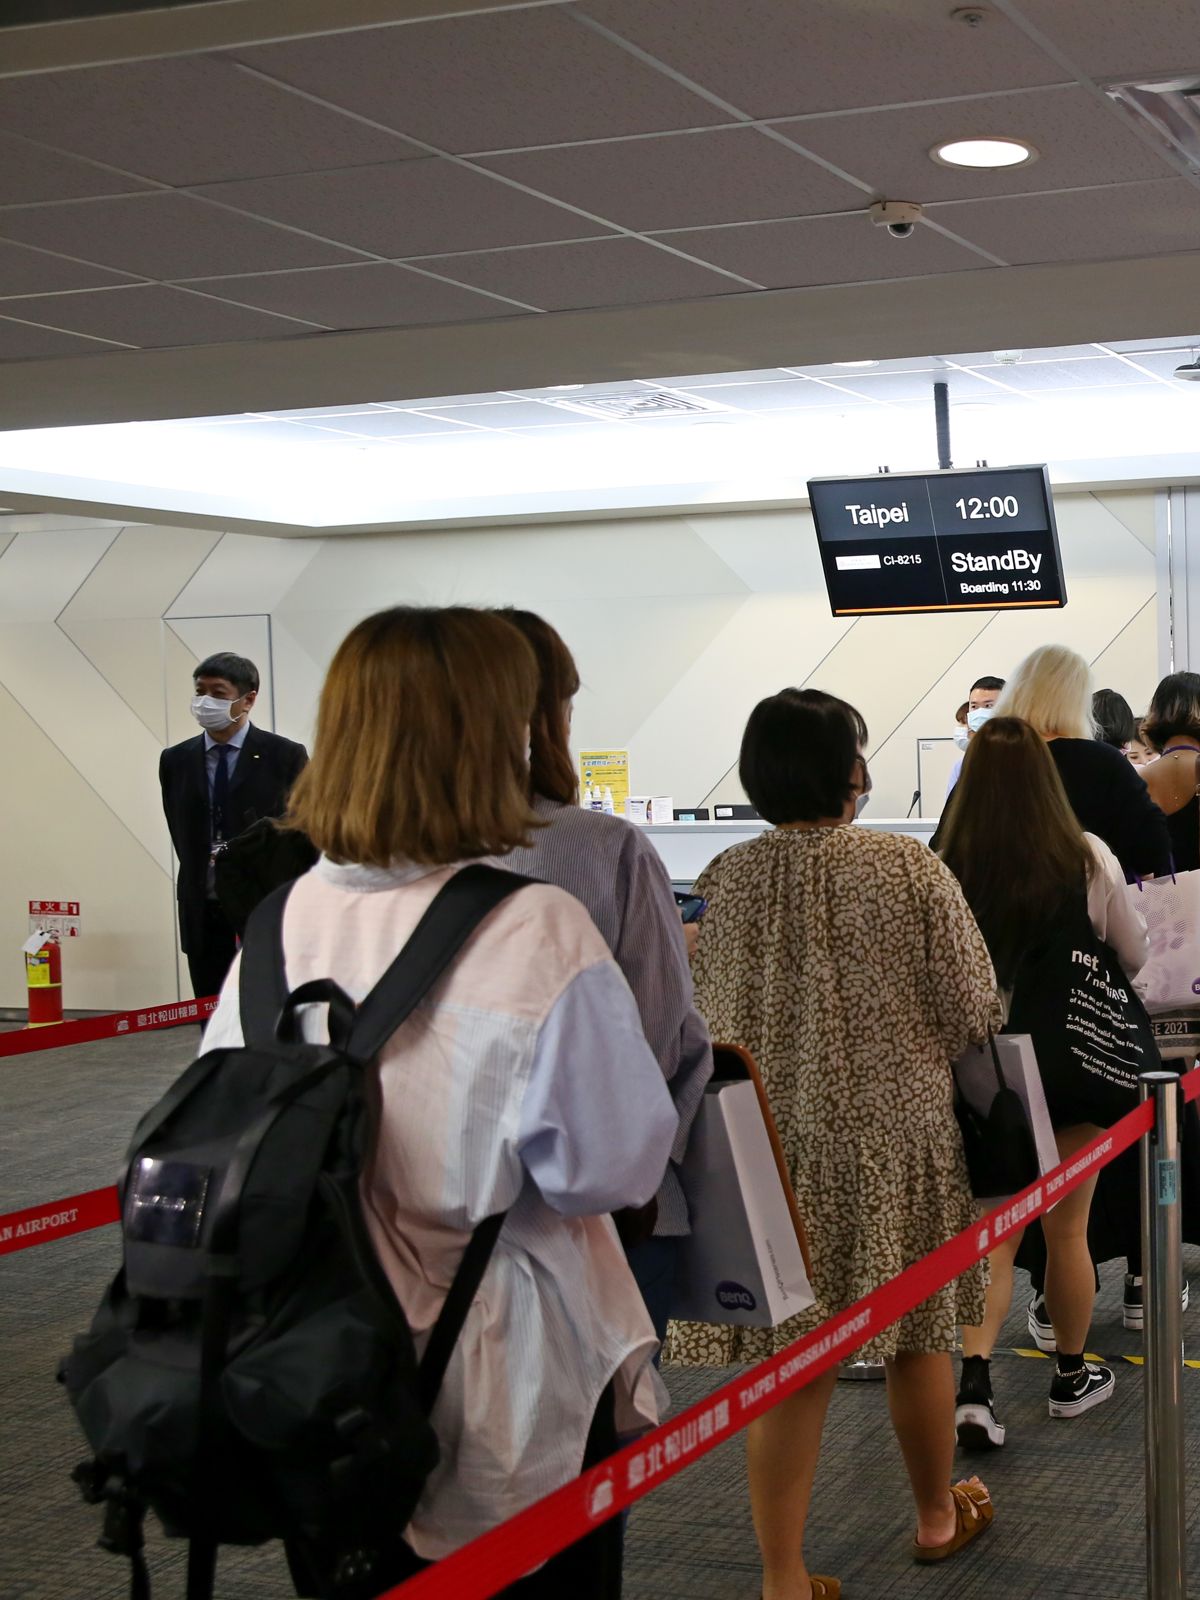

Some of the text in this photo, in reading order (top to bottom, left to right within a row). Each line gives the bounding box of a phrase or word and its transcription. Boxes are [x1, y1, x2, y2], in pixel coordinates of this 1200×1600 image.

[845, 495, 1019, 528] Taipei 12:00
[883, 554, 922, 565] CI-8215
[951, 549, 1042, 574] StandBy
[960, 579, 1042, 594] Boarding 11:30
[1066, 1023, 1084, 1033] social
[1164, 1022, 1188, 1035] 2021
[1092, 1137, 1113, 1160] AIRPORT
[16, 1209, 79, 1238] AIRPORT
[739, 1371, 776, 1410] TAIPEI
[778, 1334, 832, 1384] SONGSHAN
[831, 1307, 872, 1348] AIRPORT
